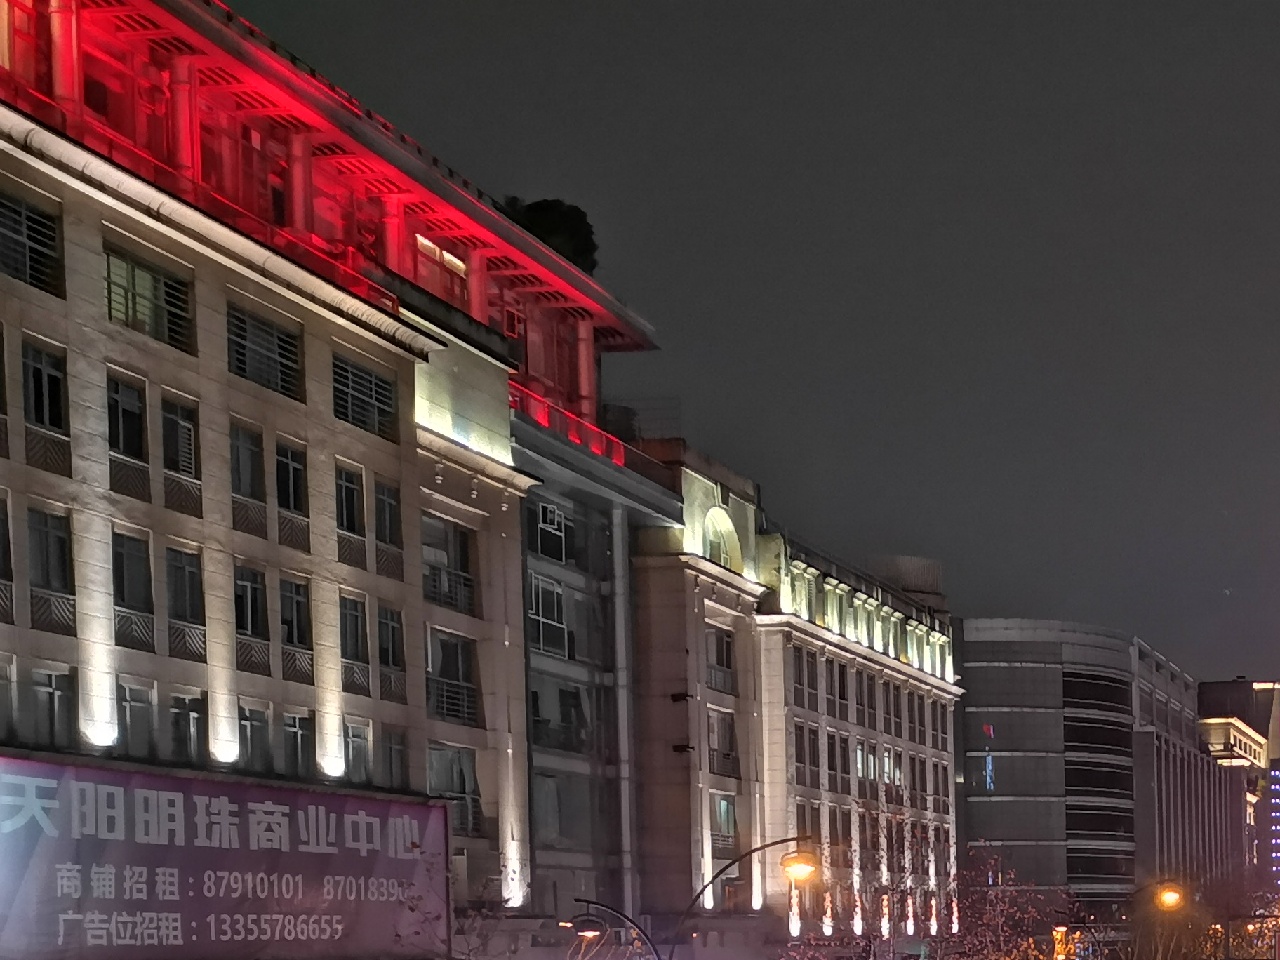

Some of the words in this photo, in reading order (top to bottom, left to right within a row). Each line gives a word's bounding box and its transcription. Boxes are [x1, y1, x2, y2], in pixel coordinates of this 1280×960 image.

[0, 774, 420, 859] 天阳明珠商业中心
